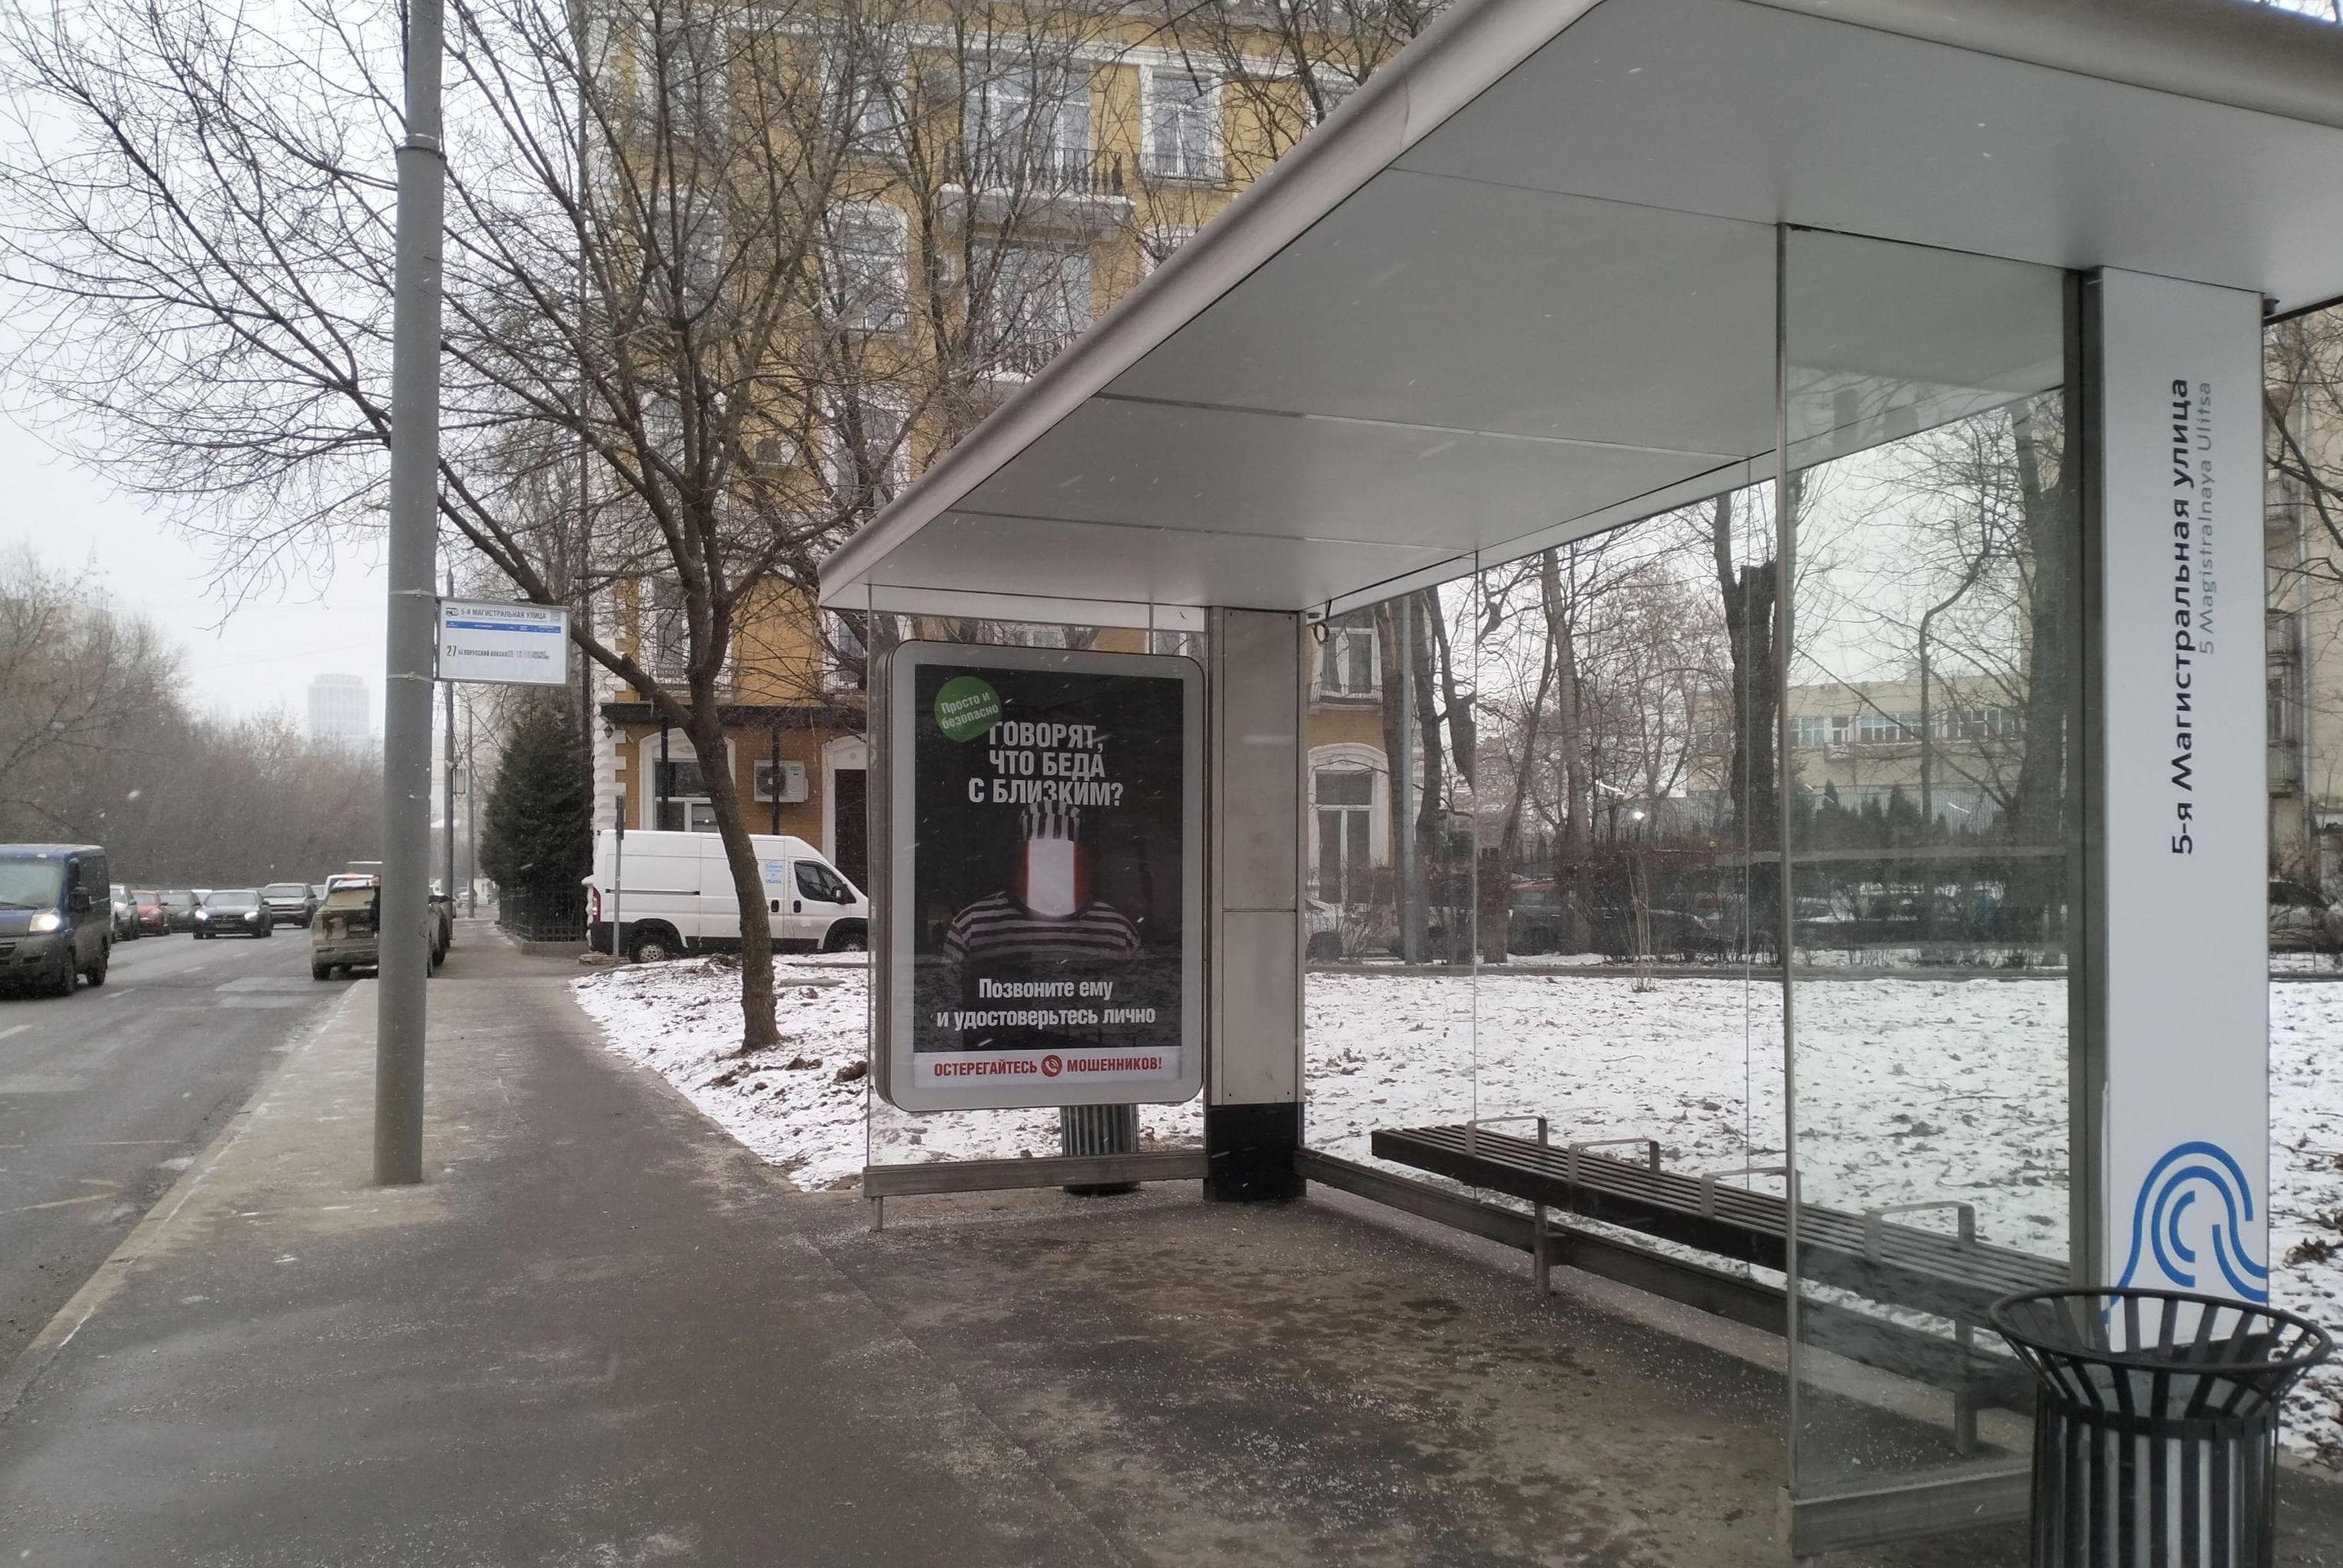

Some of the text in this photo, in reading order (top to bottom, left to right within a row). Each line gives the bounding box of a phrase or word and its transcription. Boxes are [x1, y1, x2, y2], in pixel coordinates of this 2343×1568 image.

[2196, 382, 2217, 655] 5 Magistralnaya Ulitsa
[472, 609, 524, 619] МАГИСТРАЛЬНАЯ
[2171, 379, 2196, 854] 5-я Магистральная улица
[446, 645, 456, 657] 27
[941, 692, 990, 714] Просто и
[941, 704, 998, 729] безопасно
[989, 721, 1103, 753] ГОВОРЯТ,
[989, 750, 1105, 781] ЧТО БЕДА
[969, 778, 1124, 806] С БЛИЗКИМ?
[979, 978, 1113, 1001] Позвоните ему
[936, 1008, 1155, 1031] и удостоверьтесь лично
[934, 1057, 1162, 1076] ОСТЕРЕГАЙТЕСЬ МОШЕННИКОВ!
